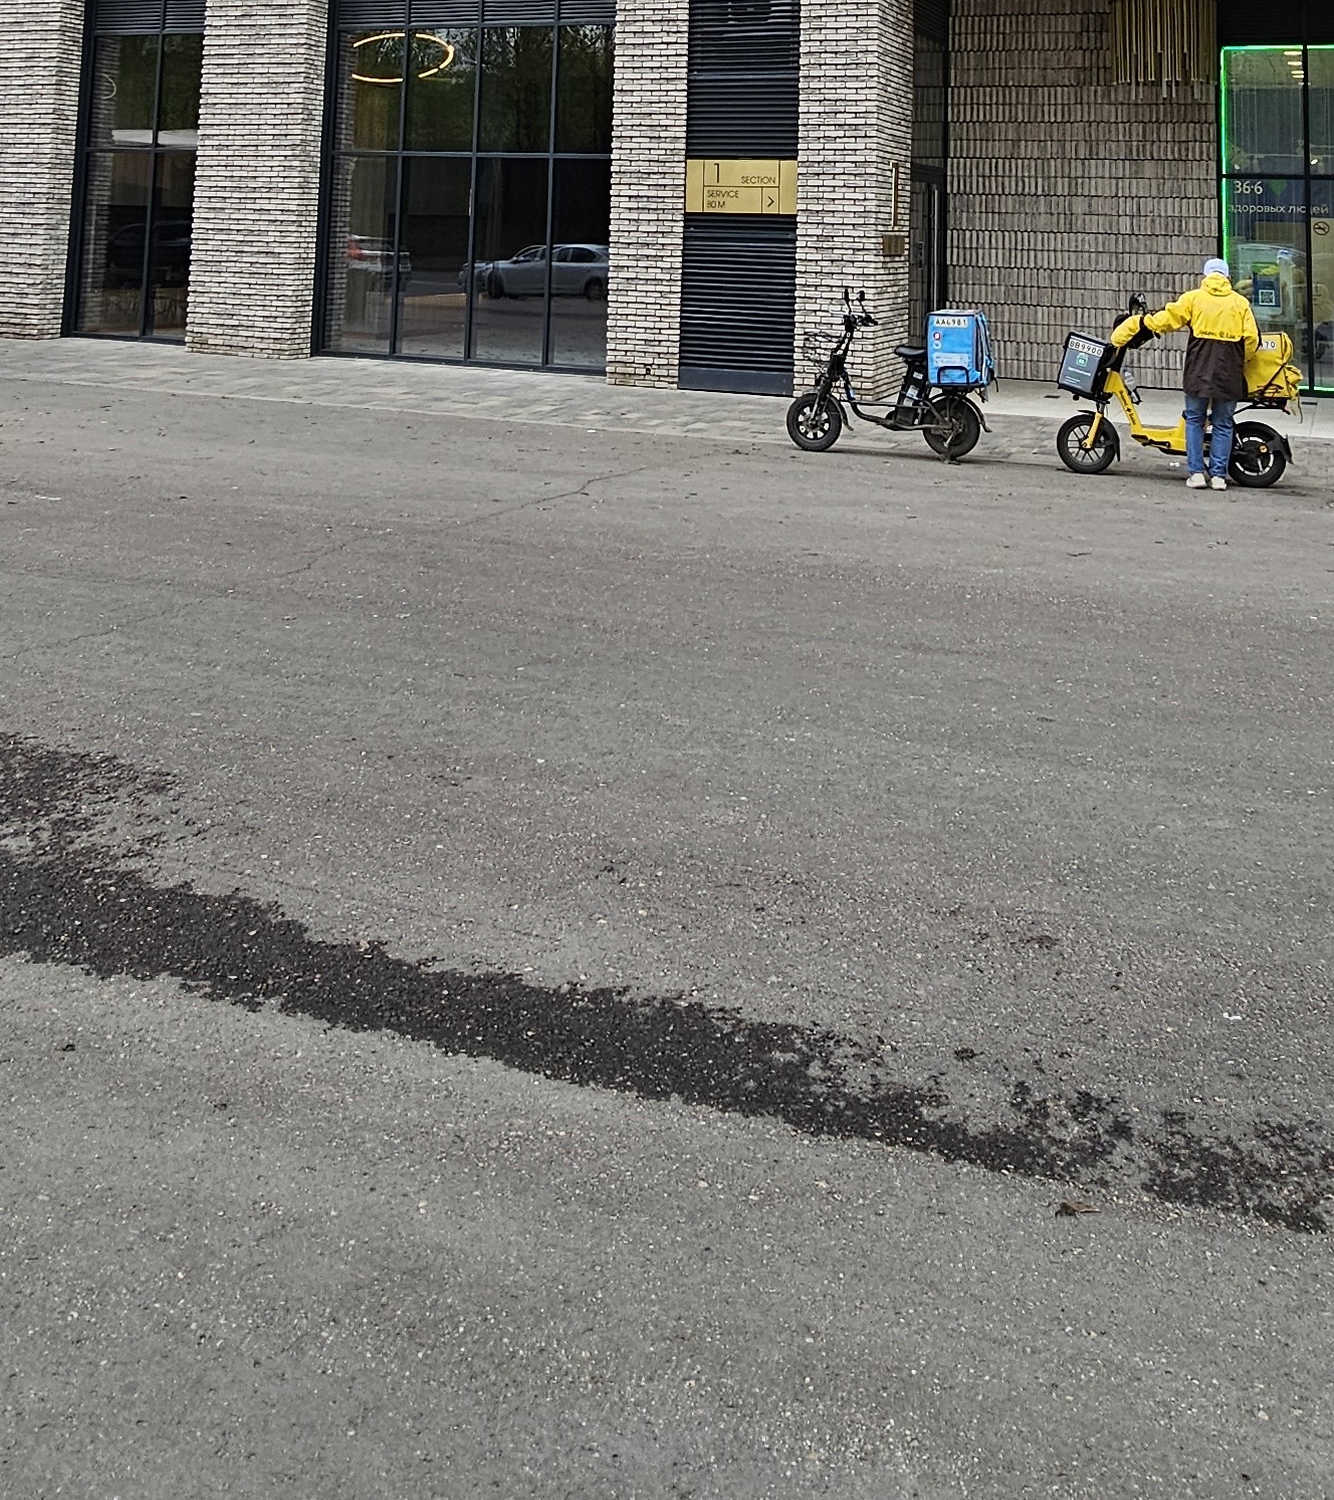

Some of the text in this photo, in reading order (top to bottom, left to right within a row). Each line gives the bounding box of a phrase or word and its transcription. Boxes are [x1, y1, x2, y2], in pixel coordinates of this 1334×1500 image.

[713, 163, 720, 184] 1
[740, 176, 777, 185] SECTION
[706, 190, 740, 199] SERVICE
[1228, 203, 1329, 215] здоровых люей
